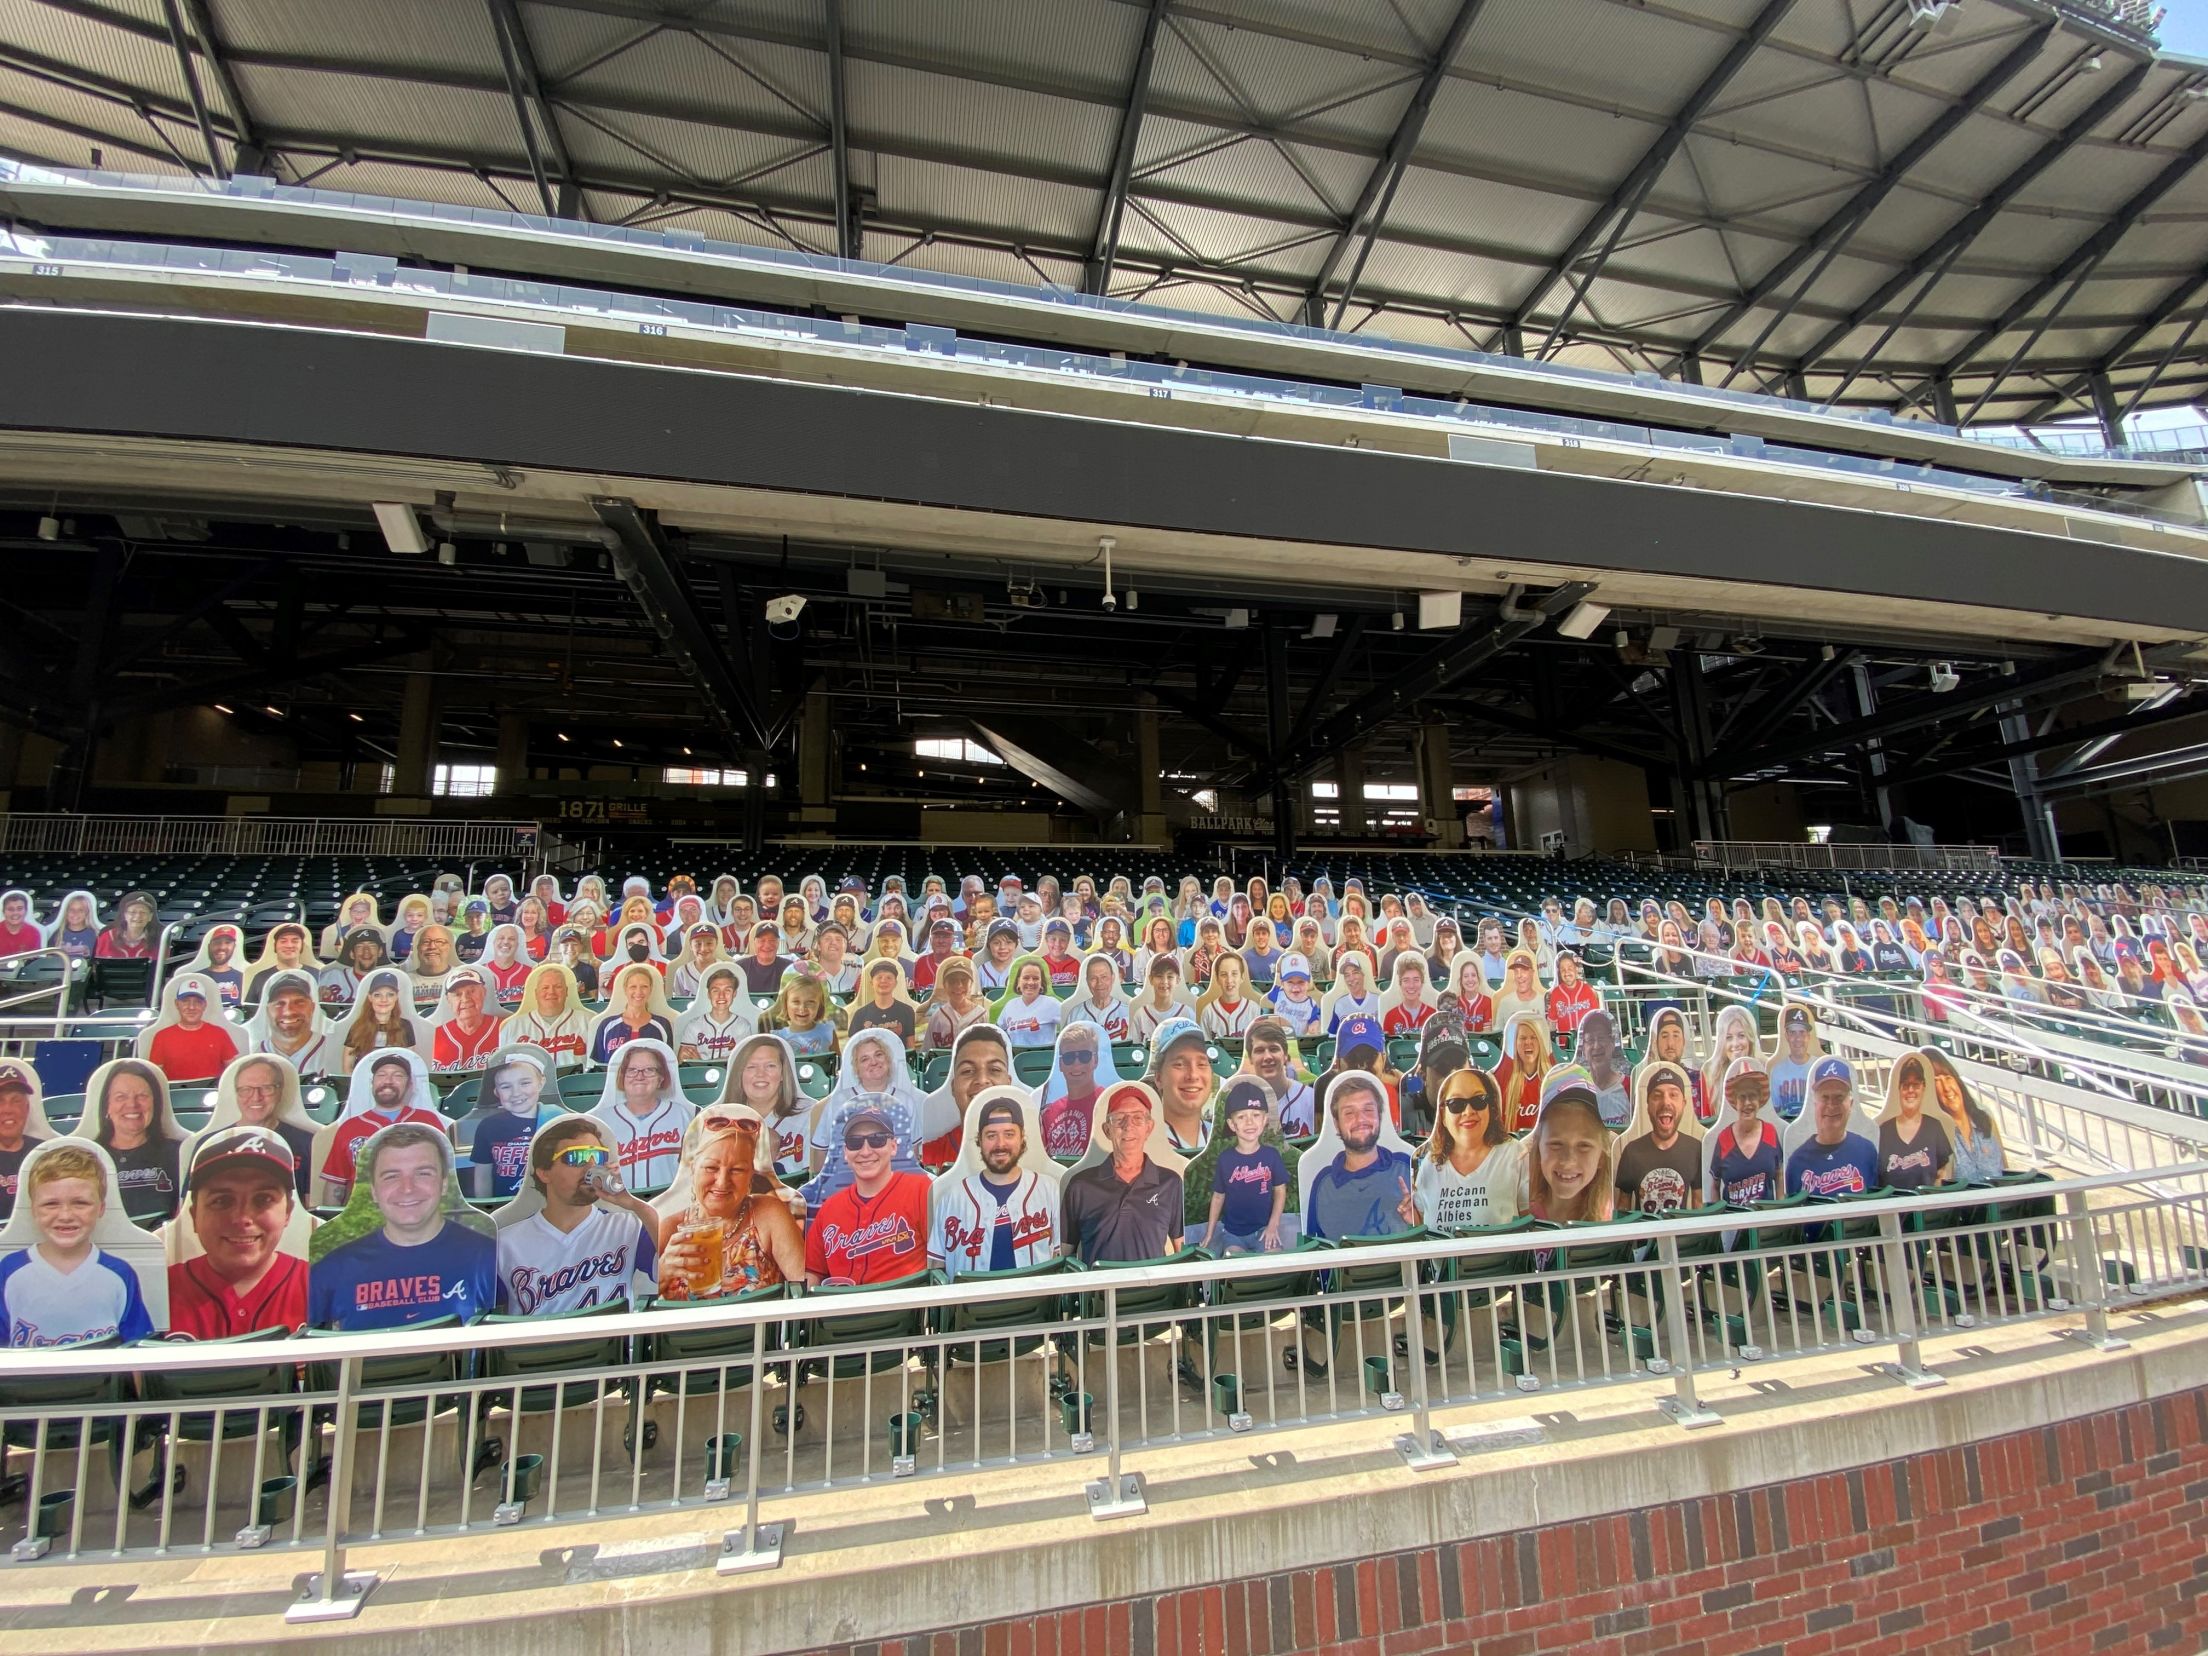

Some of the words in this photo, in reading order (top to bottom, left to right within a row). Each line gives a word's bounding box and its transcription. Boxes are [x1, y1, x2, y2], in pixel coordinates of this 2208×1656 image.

[36, 265, 59, 277] 315
[643, 324, 664, 336] 316
[1152, 389, 1169, 399] 317
[558, 800, 605, 818] 1871
[608, 803, 648, 812] GRILLE
[1190, 816, 1251, 830] BALLPARK
[617, 1127, 680, 1155] raves
[117, 1168, 160, 1182] aves
[1801, 1164, 1854, 1194] Braves
[1440, 1186, 1486, 1198] McCann
[1438, 1196, 1489, 1209] Freeman
[1436, 1209, 1472, 1223] Albies
[823, 1212, 896, 1259] Braves
[511, 1244, 630, 1315] Braves
[355, 1275, 441, 1304] BRAVES
[368, 1299, 415, 1309] BASEBALL
[418, 1295, 441, 1303] CLUB
